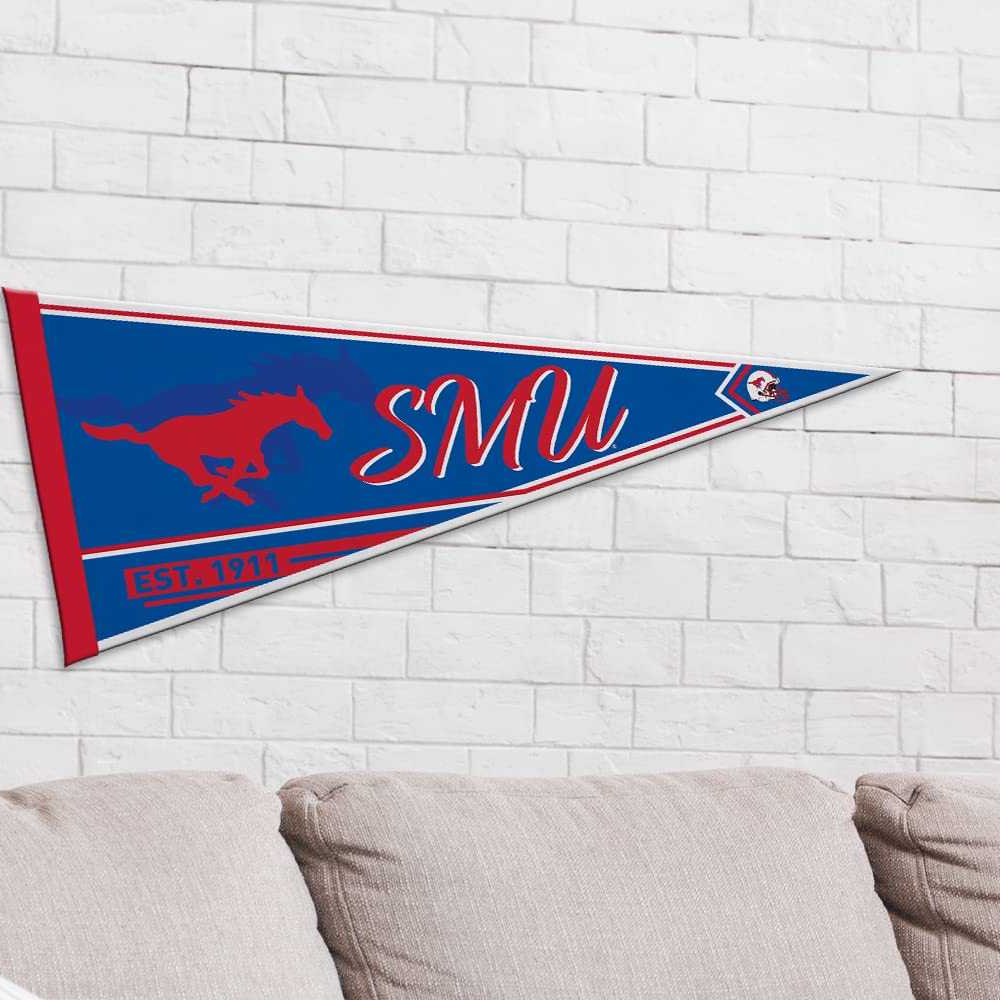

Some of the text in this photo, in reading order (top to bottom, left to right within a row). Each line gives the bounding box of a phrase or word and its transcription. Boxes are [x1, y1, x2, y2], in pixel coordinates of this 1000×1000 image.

[349, 365, 629, 486] SMU
[134, 552, 279, 594] EST. 1911
